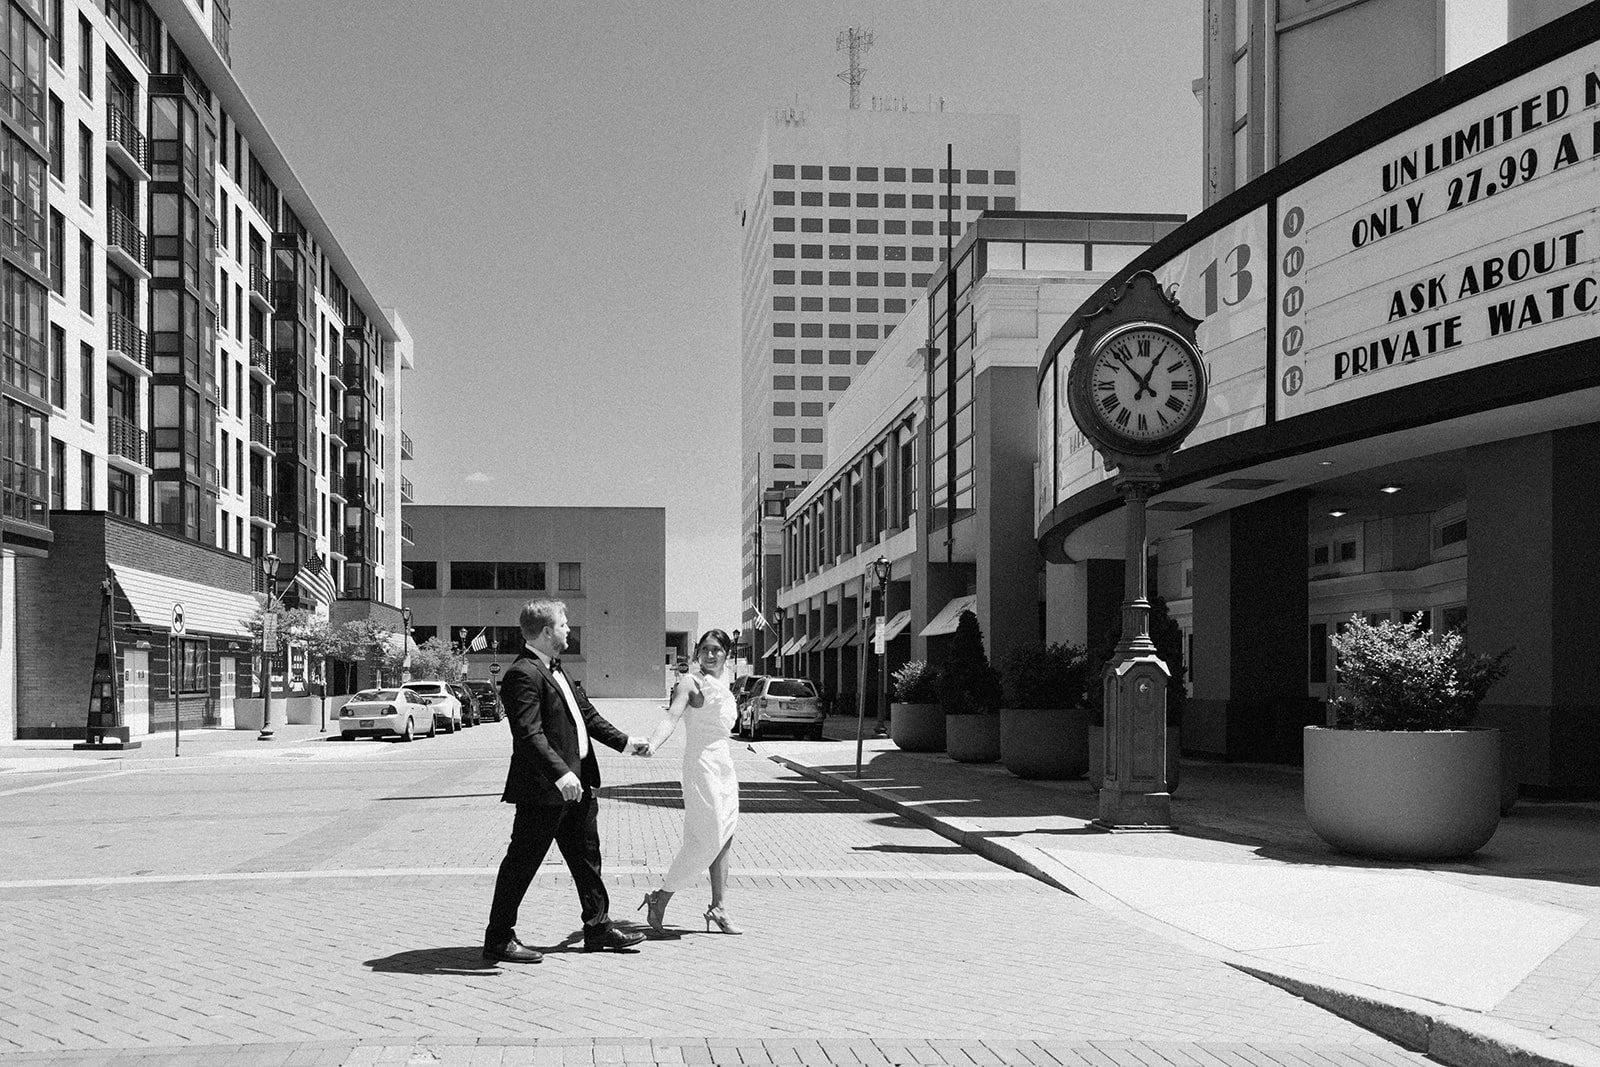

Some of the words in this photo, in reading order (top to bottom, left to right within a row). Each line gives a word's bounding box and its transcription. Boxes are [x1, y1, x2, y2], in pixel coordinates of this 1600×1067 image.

[1352, 193, 1424, 248] ONLY
[1447, 148, 1538, 211] 27.99
[1553, 132, 1580, 170] A
[1382, 85, 1569, 192] UNLIMITED
[1199, 243, 1253, 318] 13
[1388, 273, 1447, 322] ASK
[1458, 229, 1584, 299] ABOUT
[1334, 315, 1463, 381] PRIVATE
[1487, 277, 1598, 336] WATC
